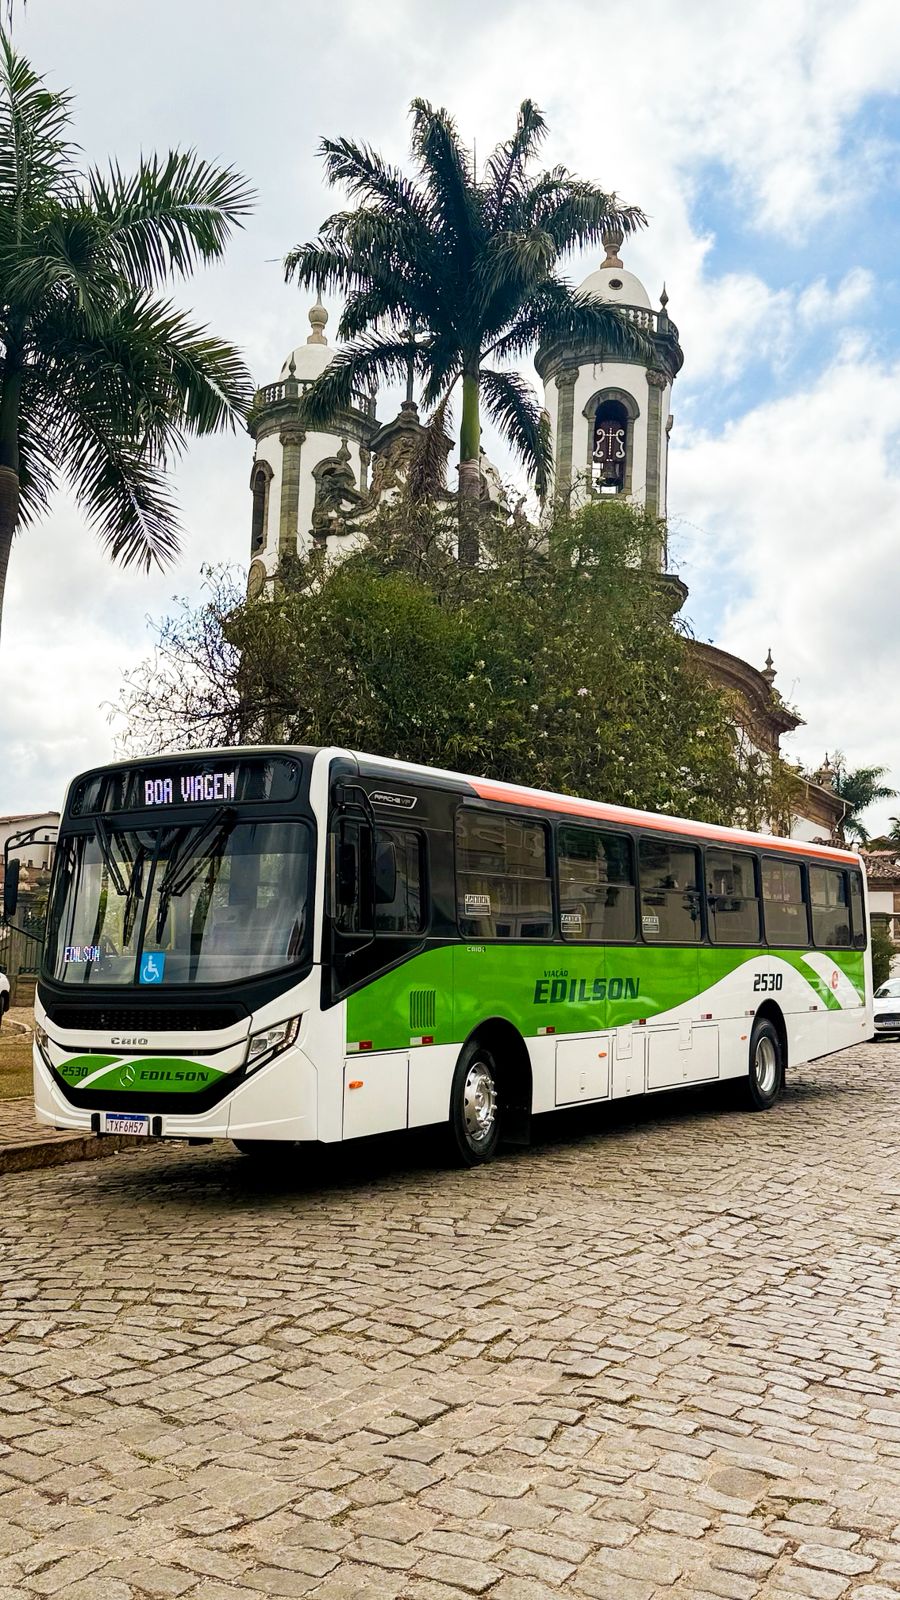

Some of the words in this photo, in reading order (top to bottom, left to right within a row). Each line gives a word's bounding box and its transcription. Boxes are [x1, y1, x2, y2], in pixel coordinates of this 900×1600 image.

[144, 779, 173, 805] BOA
[180, 772, 235, 802] VIAGEM
[64, 945, 101, 963] EDILSON
[533, 977, 640, 1004] EDILSON
[753, 973, 783, 992] 2530
[61, 1065, 89, 1077] 2530
[139, 1070, 210, 1082] EDILSON
[110, 1120, 144, 1134] TXF6H57
